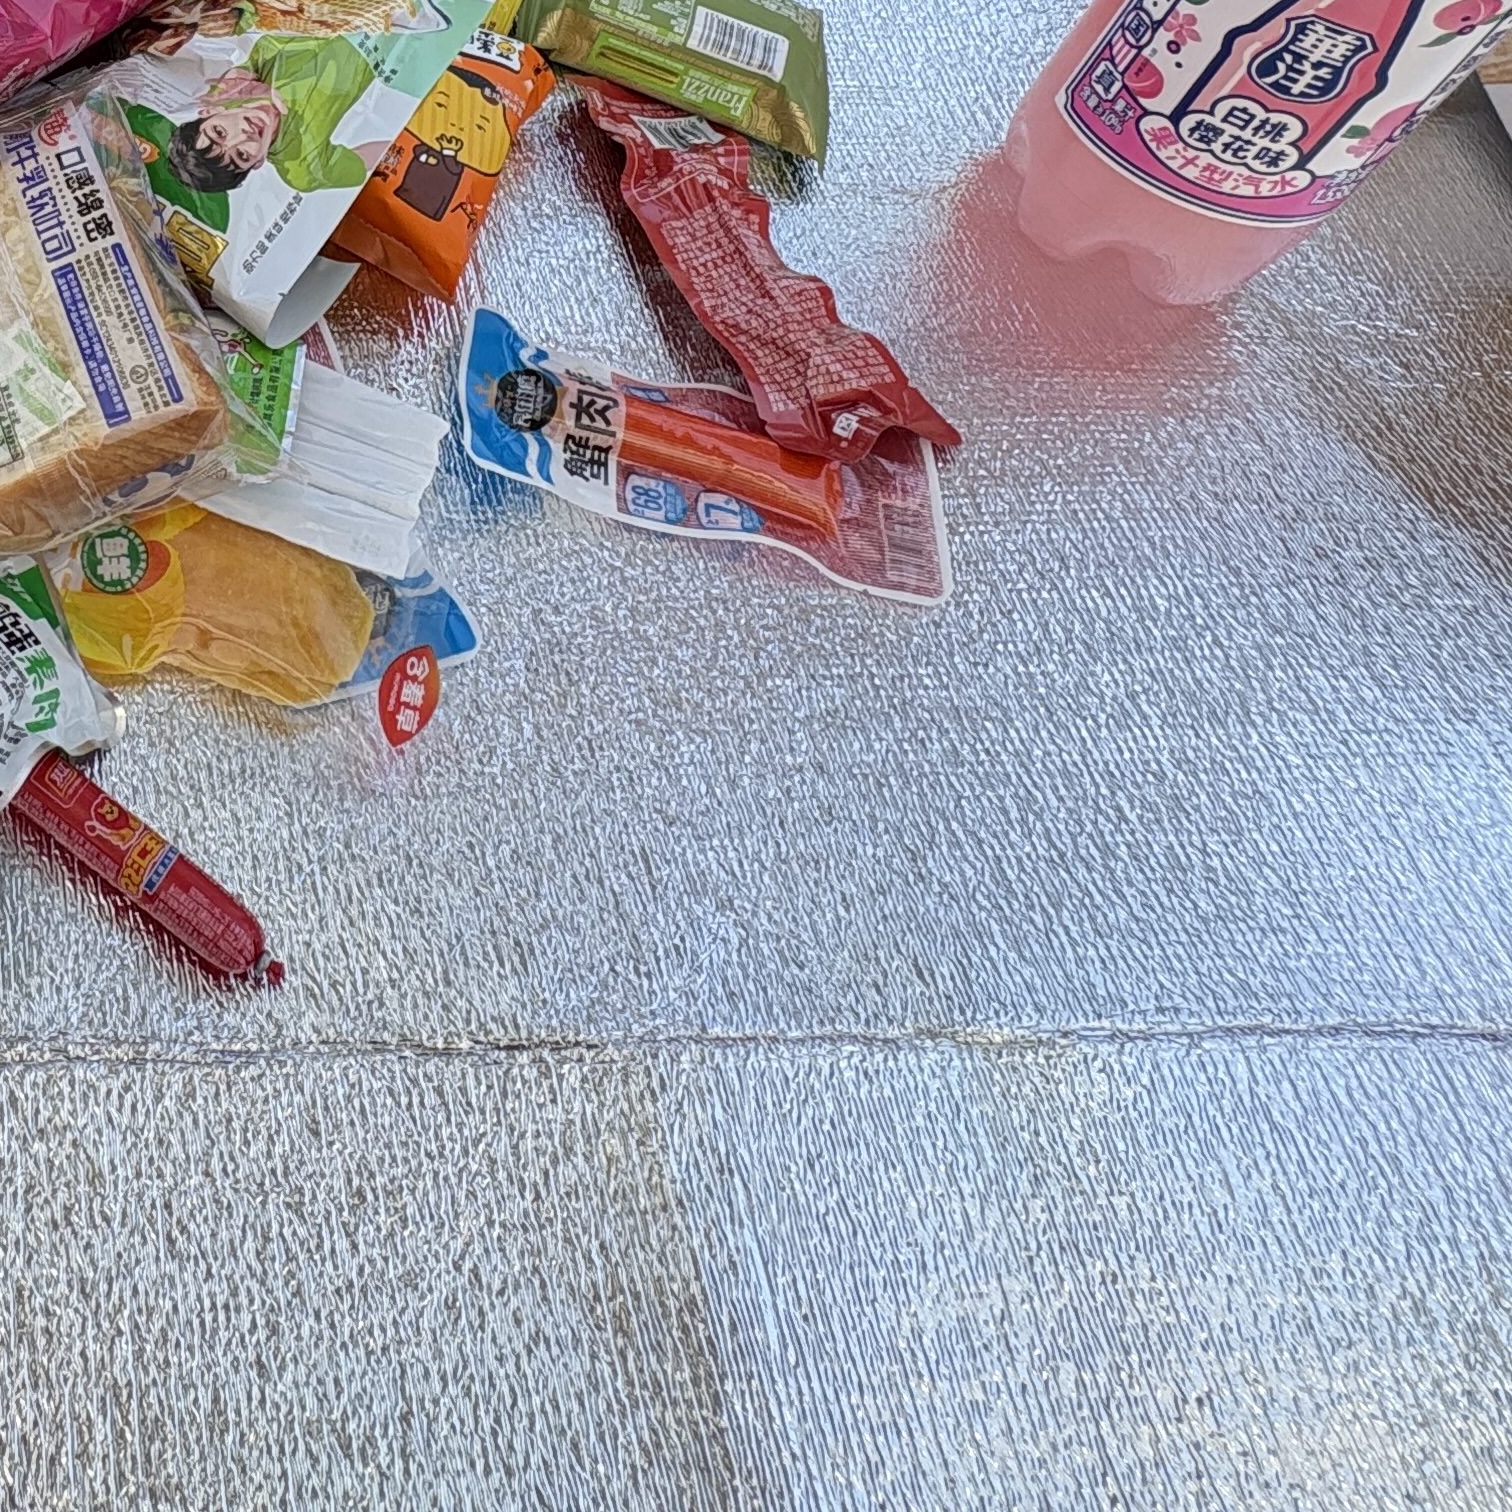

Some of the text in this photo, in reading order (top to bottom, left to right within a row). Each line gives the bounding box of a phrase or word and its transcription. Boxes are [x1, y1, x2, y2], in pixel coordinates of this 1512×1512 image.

[680, 74, 751, 117] Franzzi
[1186, 118, 1293, 170] 樱花味
[1219, 103, 1293, 143] 白桃
[1144, 122, 1301, 196] 果汁型汽水
[50, 143, 117, 245] 口感绵密
[95, 536, 133, 583] 鲜
[394, 655, 431, 735] 含羞草
